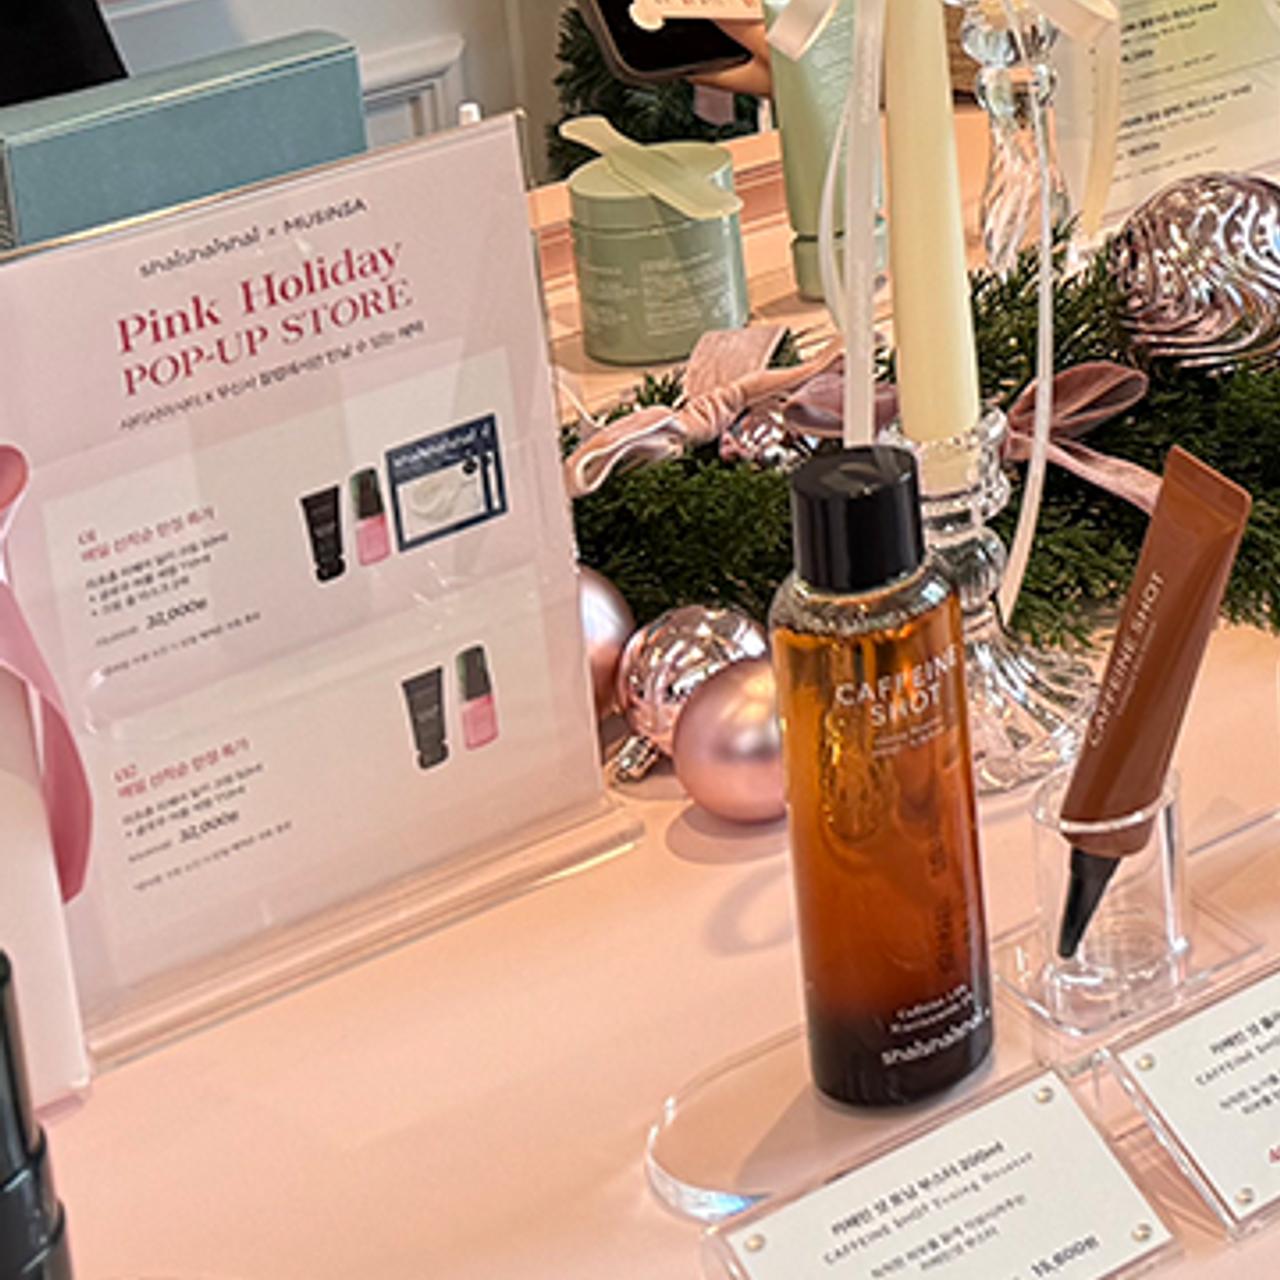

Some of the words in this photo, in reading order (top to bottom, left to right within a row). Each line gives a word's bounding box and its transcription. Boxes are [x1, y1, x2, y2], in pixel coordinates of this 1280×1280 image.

[282, 196, 368, 235] MUSINSA
[116, 294, 221, 354] Pink
[239, 241, 404, 316] Holiday
[122, 324, 268, 397] POP-UP
[280, 278, 414, 346] STORE
[835, 643, 958, 706] CAFFEINE
[1089, 638, 1137, 749] CAFFEINE
[1131, 571, 1165, 634] SHOT
[871, 682, 941, 726] SHOT
[1195, 1050, 1256, 1087] CAFFEINE
[830, 1204, 874, 1237] 카페인
[959, 1140, 1006, 1173] 200ml
[822, 1224, 892, 1266] CAFFEINE
[894, 1202, 934, 1230] SHOT
[1031, 1234, 1101, 1280] 15,600원
